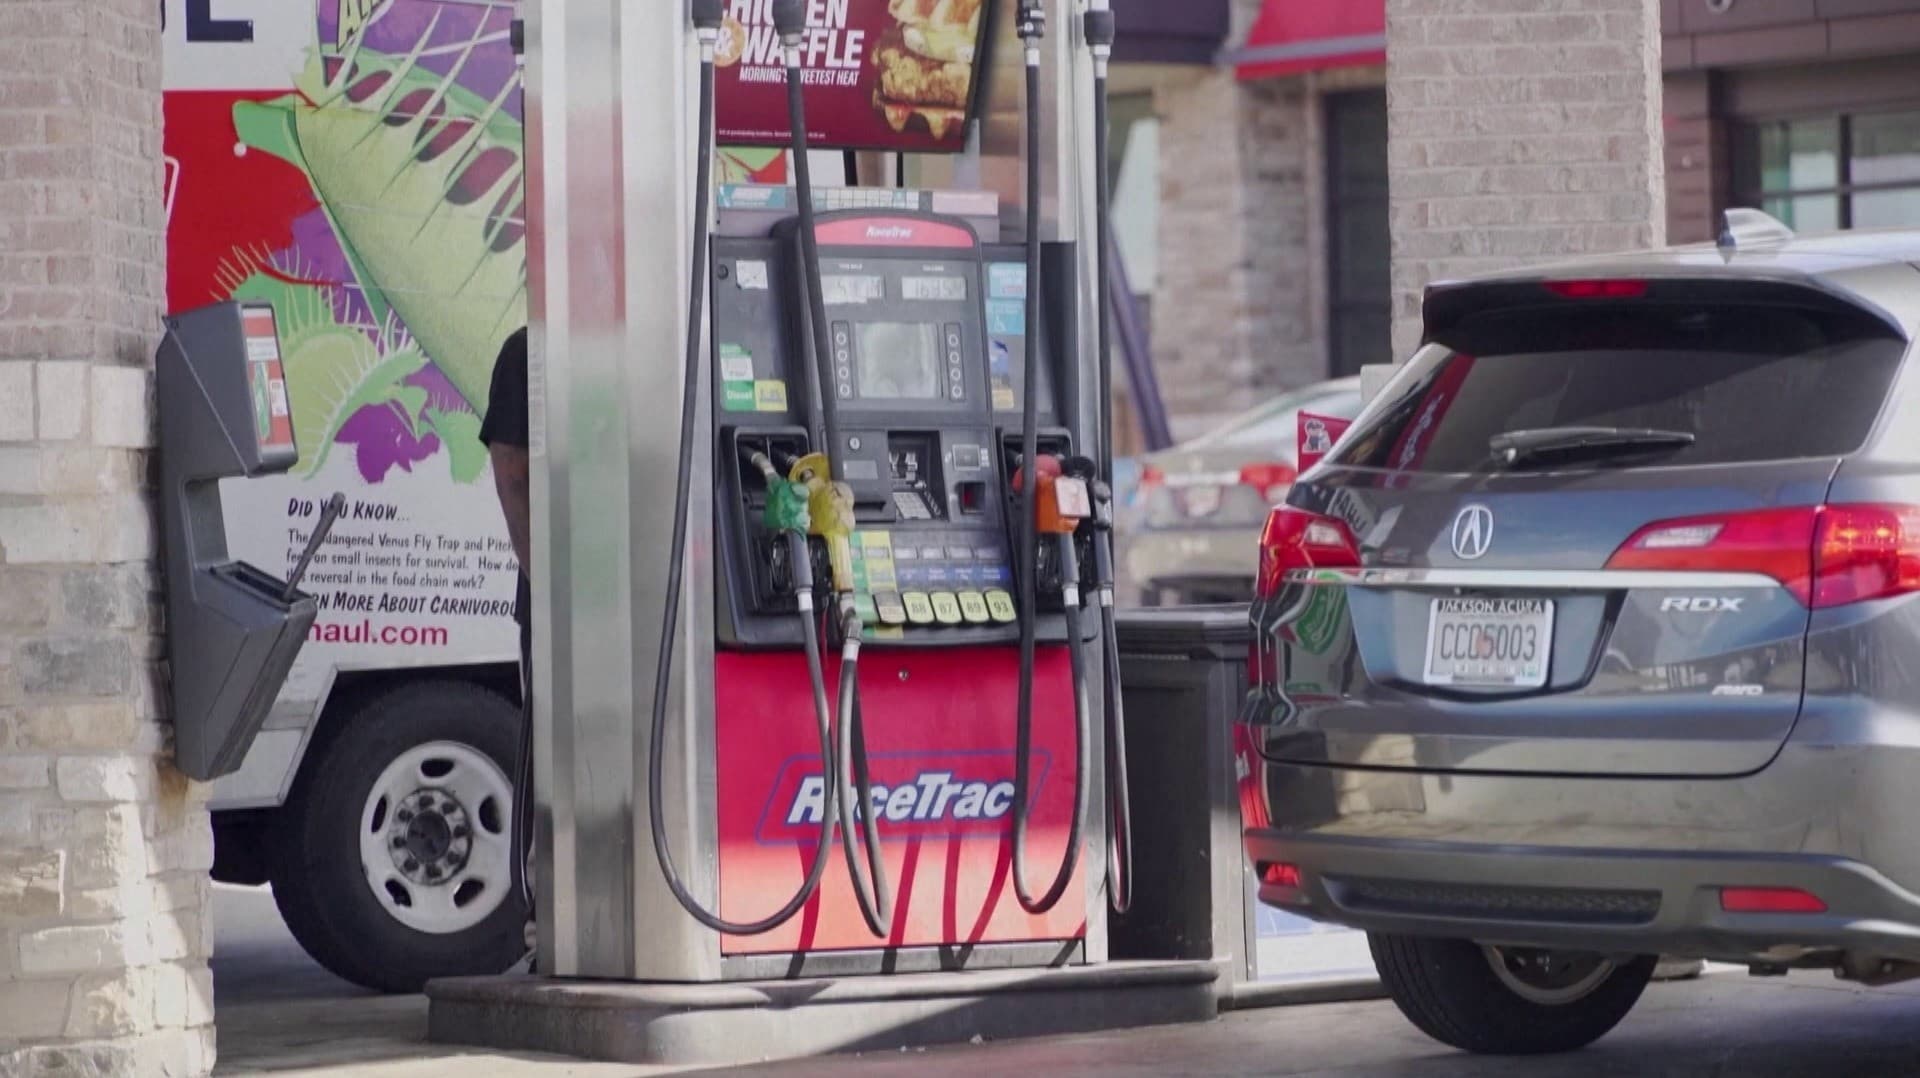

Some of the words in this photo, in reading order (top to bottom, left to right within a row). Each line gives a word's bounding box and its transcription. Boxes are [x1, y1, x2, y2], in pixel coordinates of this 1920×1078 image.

[799, 68, 835, 85] WEETEST
[836, 70, 860, 86] HEAT
[320, 498, 349, 519] YU
[288, 528, 309, 544] The
[323, 532, 374, 549] dangered
[379, 533, 409, 548] Venus
[414, 534, 431, 551] Fly
[437, 534, 460, 552] Trap
[464, 536, 483, 551] and
[286, 548, 304, 563] fee
[314, 553, 327, 563] on
[332, 552, 361, 565] small
[365, 552, 401, 567] insects
[406, 552, 421, 568] for
[425, 555, 469, 569] survival.
[478, 556, 502, 571] How
[310, 570, 353, 584] reversal
[357, 571, 367, 584] in
[371, 571, 388, 585] the
[392, 571, 416, 586] food
[420, 573, 449, 588] chain
[453, 574, 485, 589] work?
[332, 590, 374, 611] MORE
[378, 592, 427, 614] ABOUT
[993, 601, 1009, 613] 93
[1440, 599, 1495, 615] JACKSON
[1498, 600, 1543, 614] ACURA
[1660, 596, 1745, 613] RDX
[1711, 683, 1764, 696] AWD
[785, 771, 1015, 824] RceTrac
